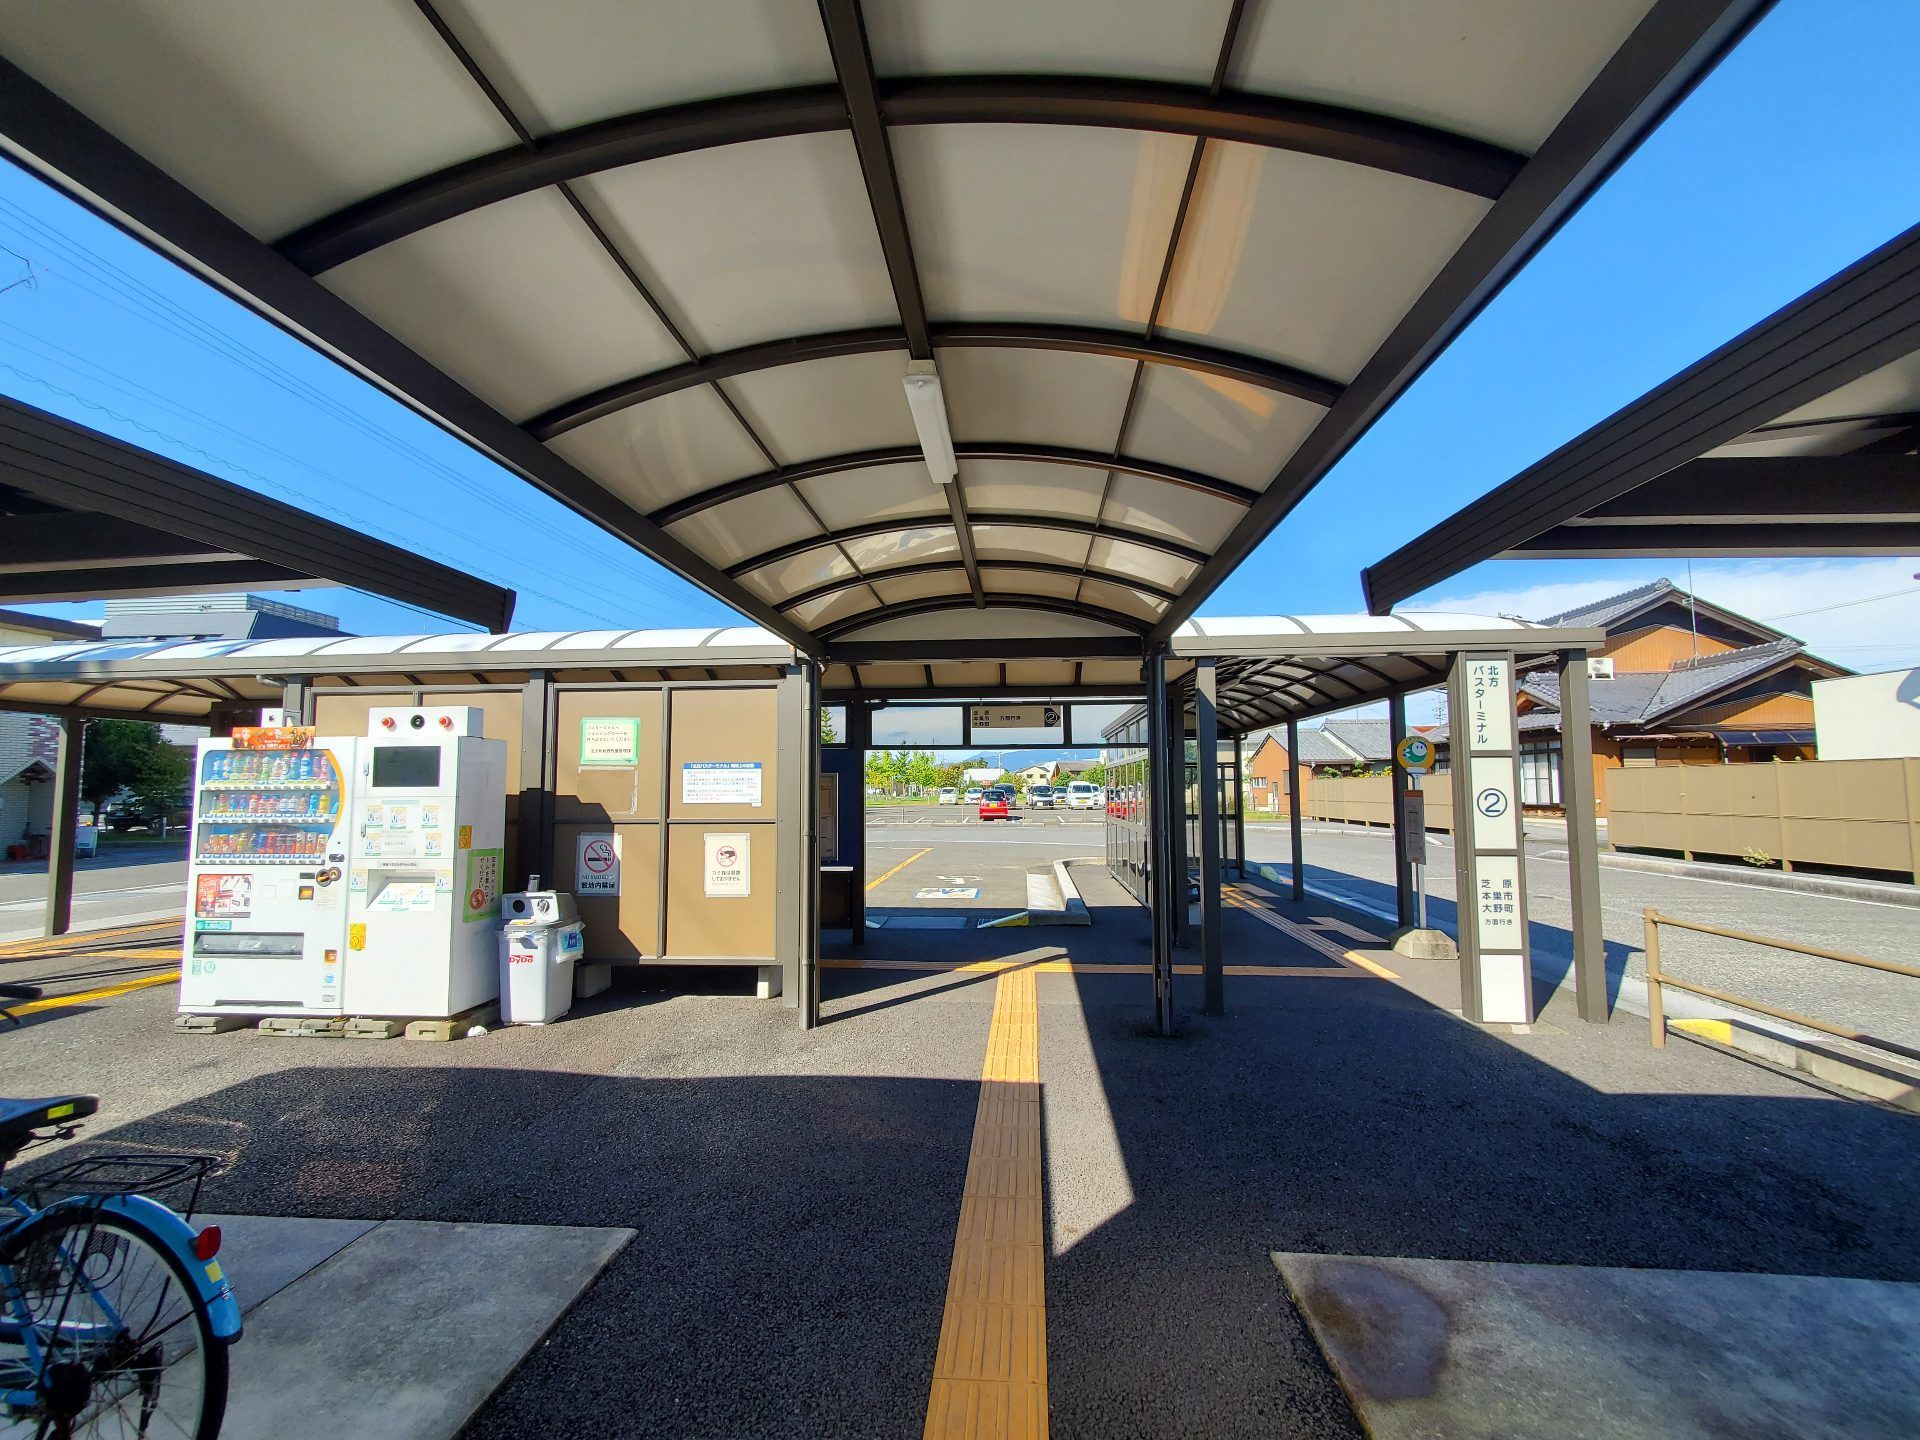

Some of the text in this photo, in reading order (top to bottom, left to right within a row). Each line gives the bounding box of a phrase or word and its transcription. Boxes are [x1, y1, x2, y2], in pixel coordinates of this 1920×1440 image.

[1488, 665, 1499, 687] 北方
[1474, 665, 1488, 744] バスターミナル
[1481, 890, 1513, 901] 本巣市
[1482, 903, 1514, 913] 大野町
[1485, 918, 1512, 926] 方面行き
[508, 955, 534, 964] DyDo
